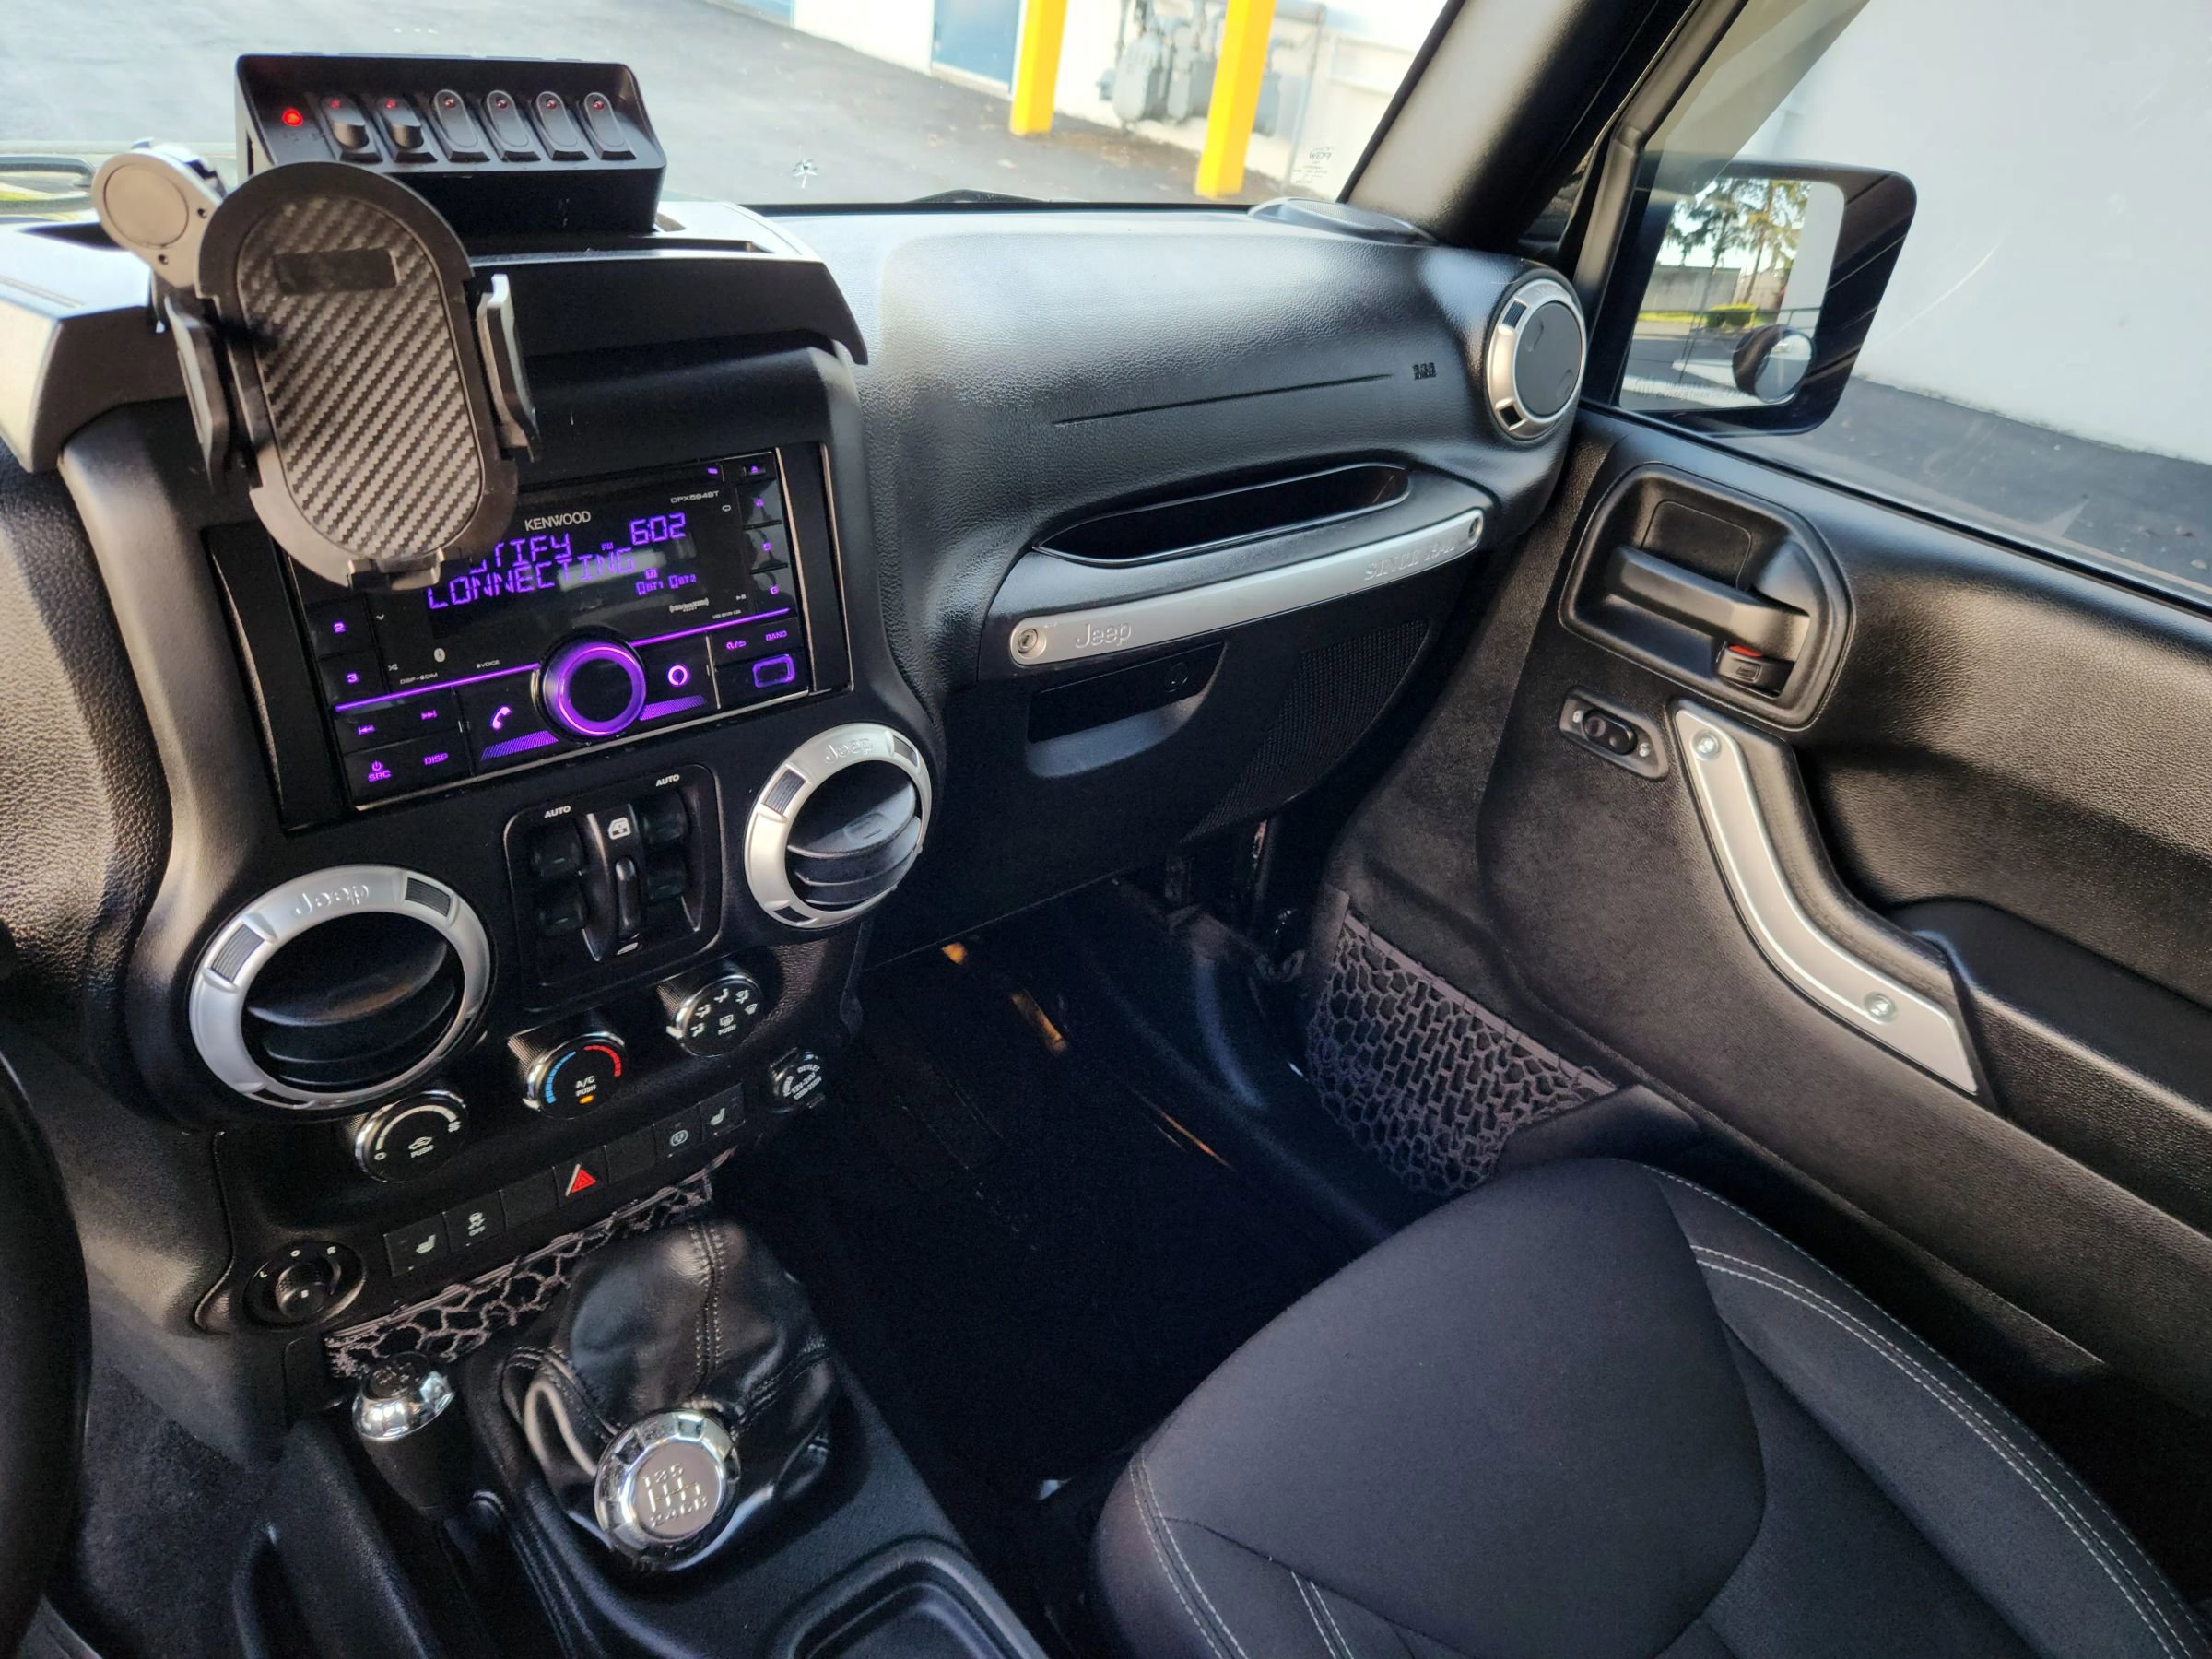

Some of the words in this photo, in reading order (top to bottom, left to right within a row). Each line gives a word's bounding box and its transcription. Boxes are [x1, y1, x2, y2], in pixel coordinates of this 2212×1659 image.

[524, 511, 592, 532] KENWOOD
[334, 621, 346, 633] 2
[766, 630, 788, 641] BAND
[1076, 623, 1132, 649] Jeep
[347, 673, 359, 684] 3
[825, 737, 873, 764] Jeep
[424, 753, 449, 766] DISP
[368, 770, 392, 782] SRC
[655, 773, 680, 787] AUTO
[544, 805, 571, 818] AUTO
[294, 884, 369, 915] Jeep
[718, 1023, 736, 1036] PUSH
[575, 1075, 595, 1089] A/C
[575, 1084, 597, 1097] PUSH
[410, 1144, 434, 1159] PUSH
[468, 1225, 486, 1237] OFF
